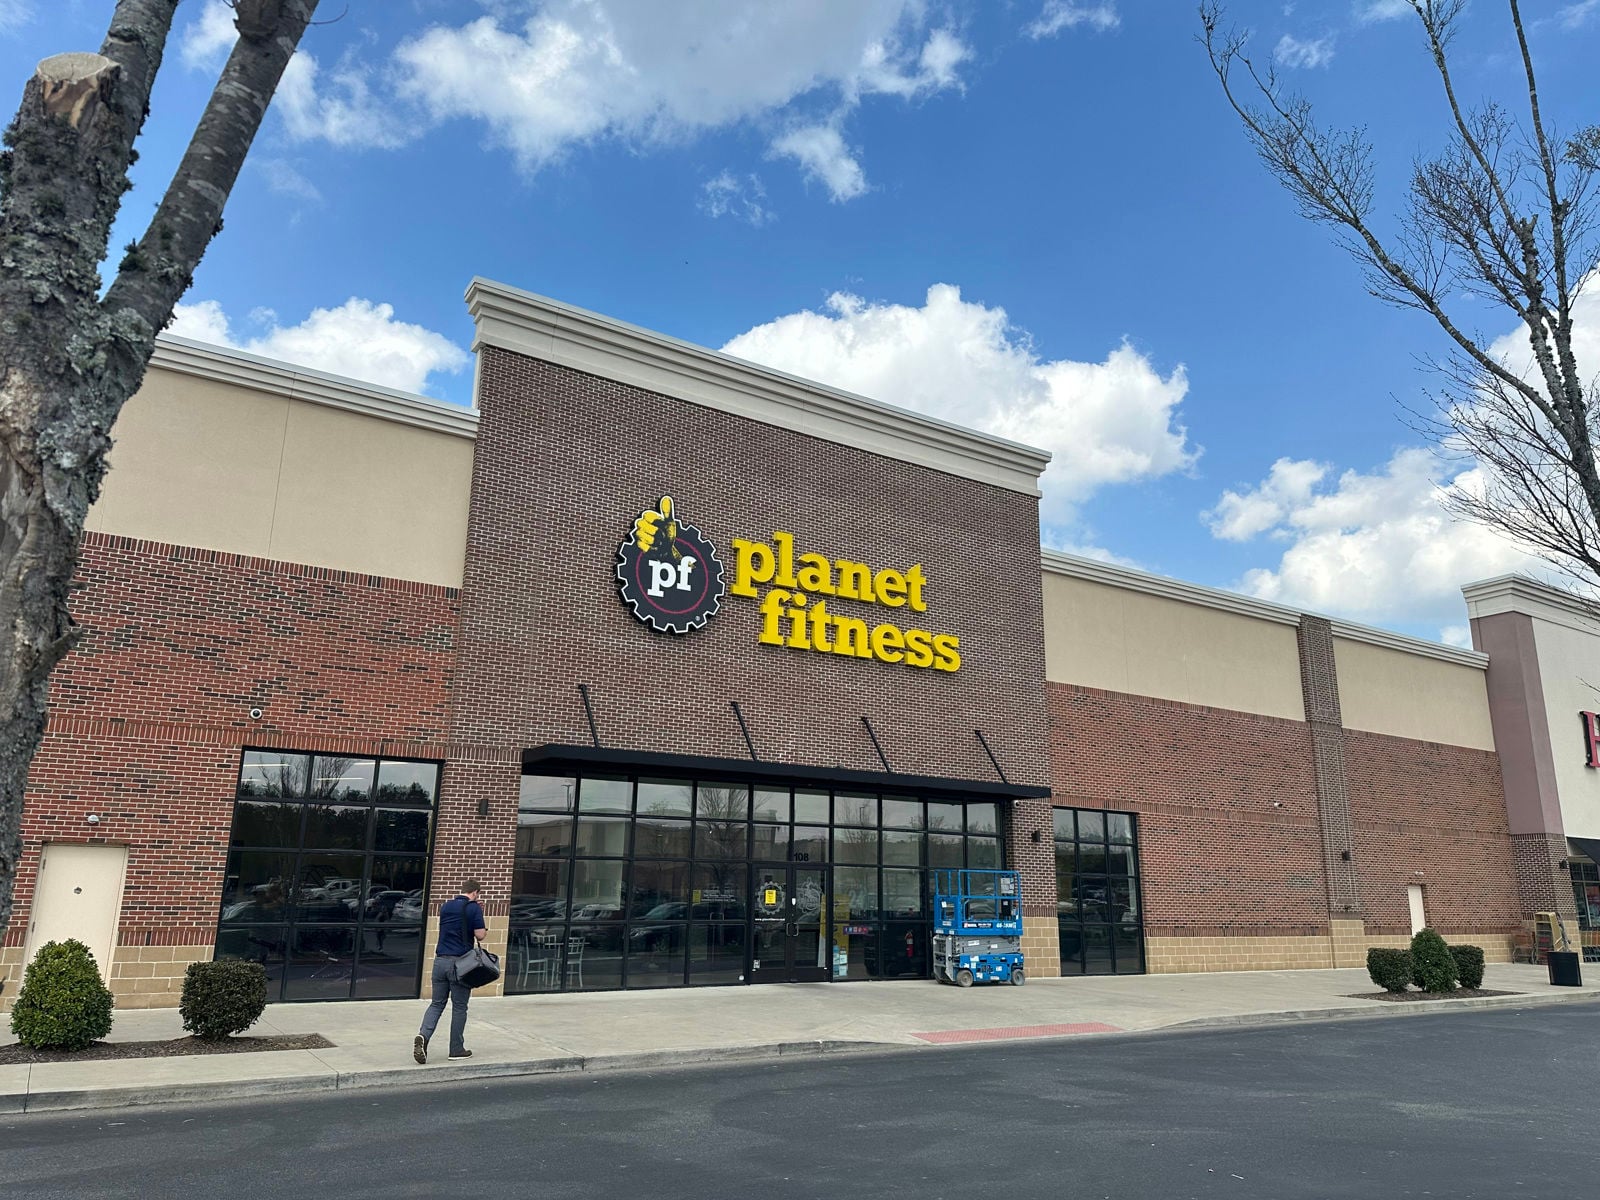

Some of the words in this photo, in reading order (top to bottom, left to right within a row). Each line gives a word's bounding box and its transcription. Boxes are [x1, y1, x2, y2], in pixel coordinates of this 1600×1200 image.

[647, 556, 697, 598] pf
[731, 531, 926, 612] planet
[758, 589, 961, 672] fitness
[794, 852, 809, 862] 108
